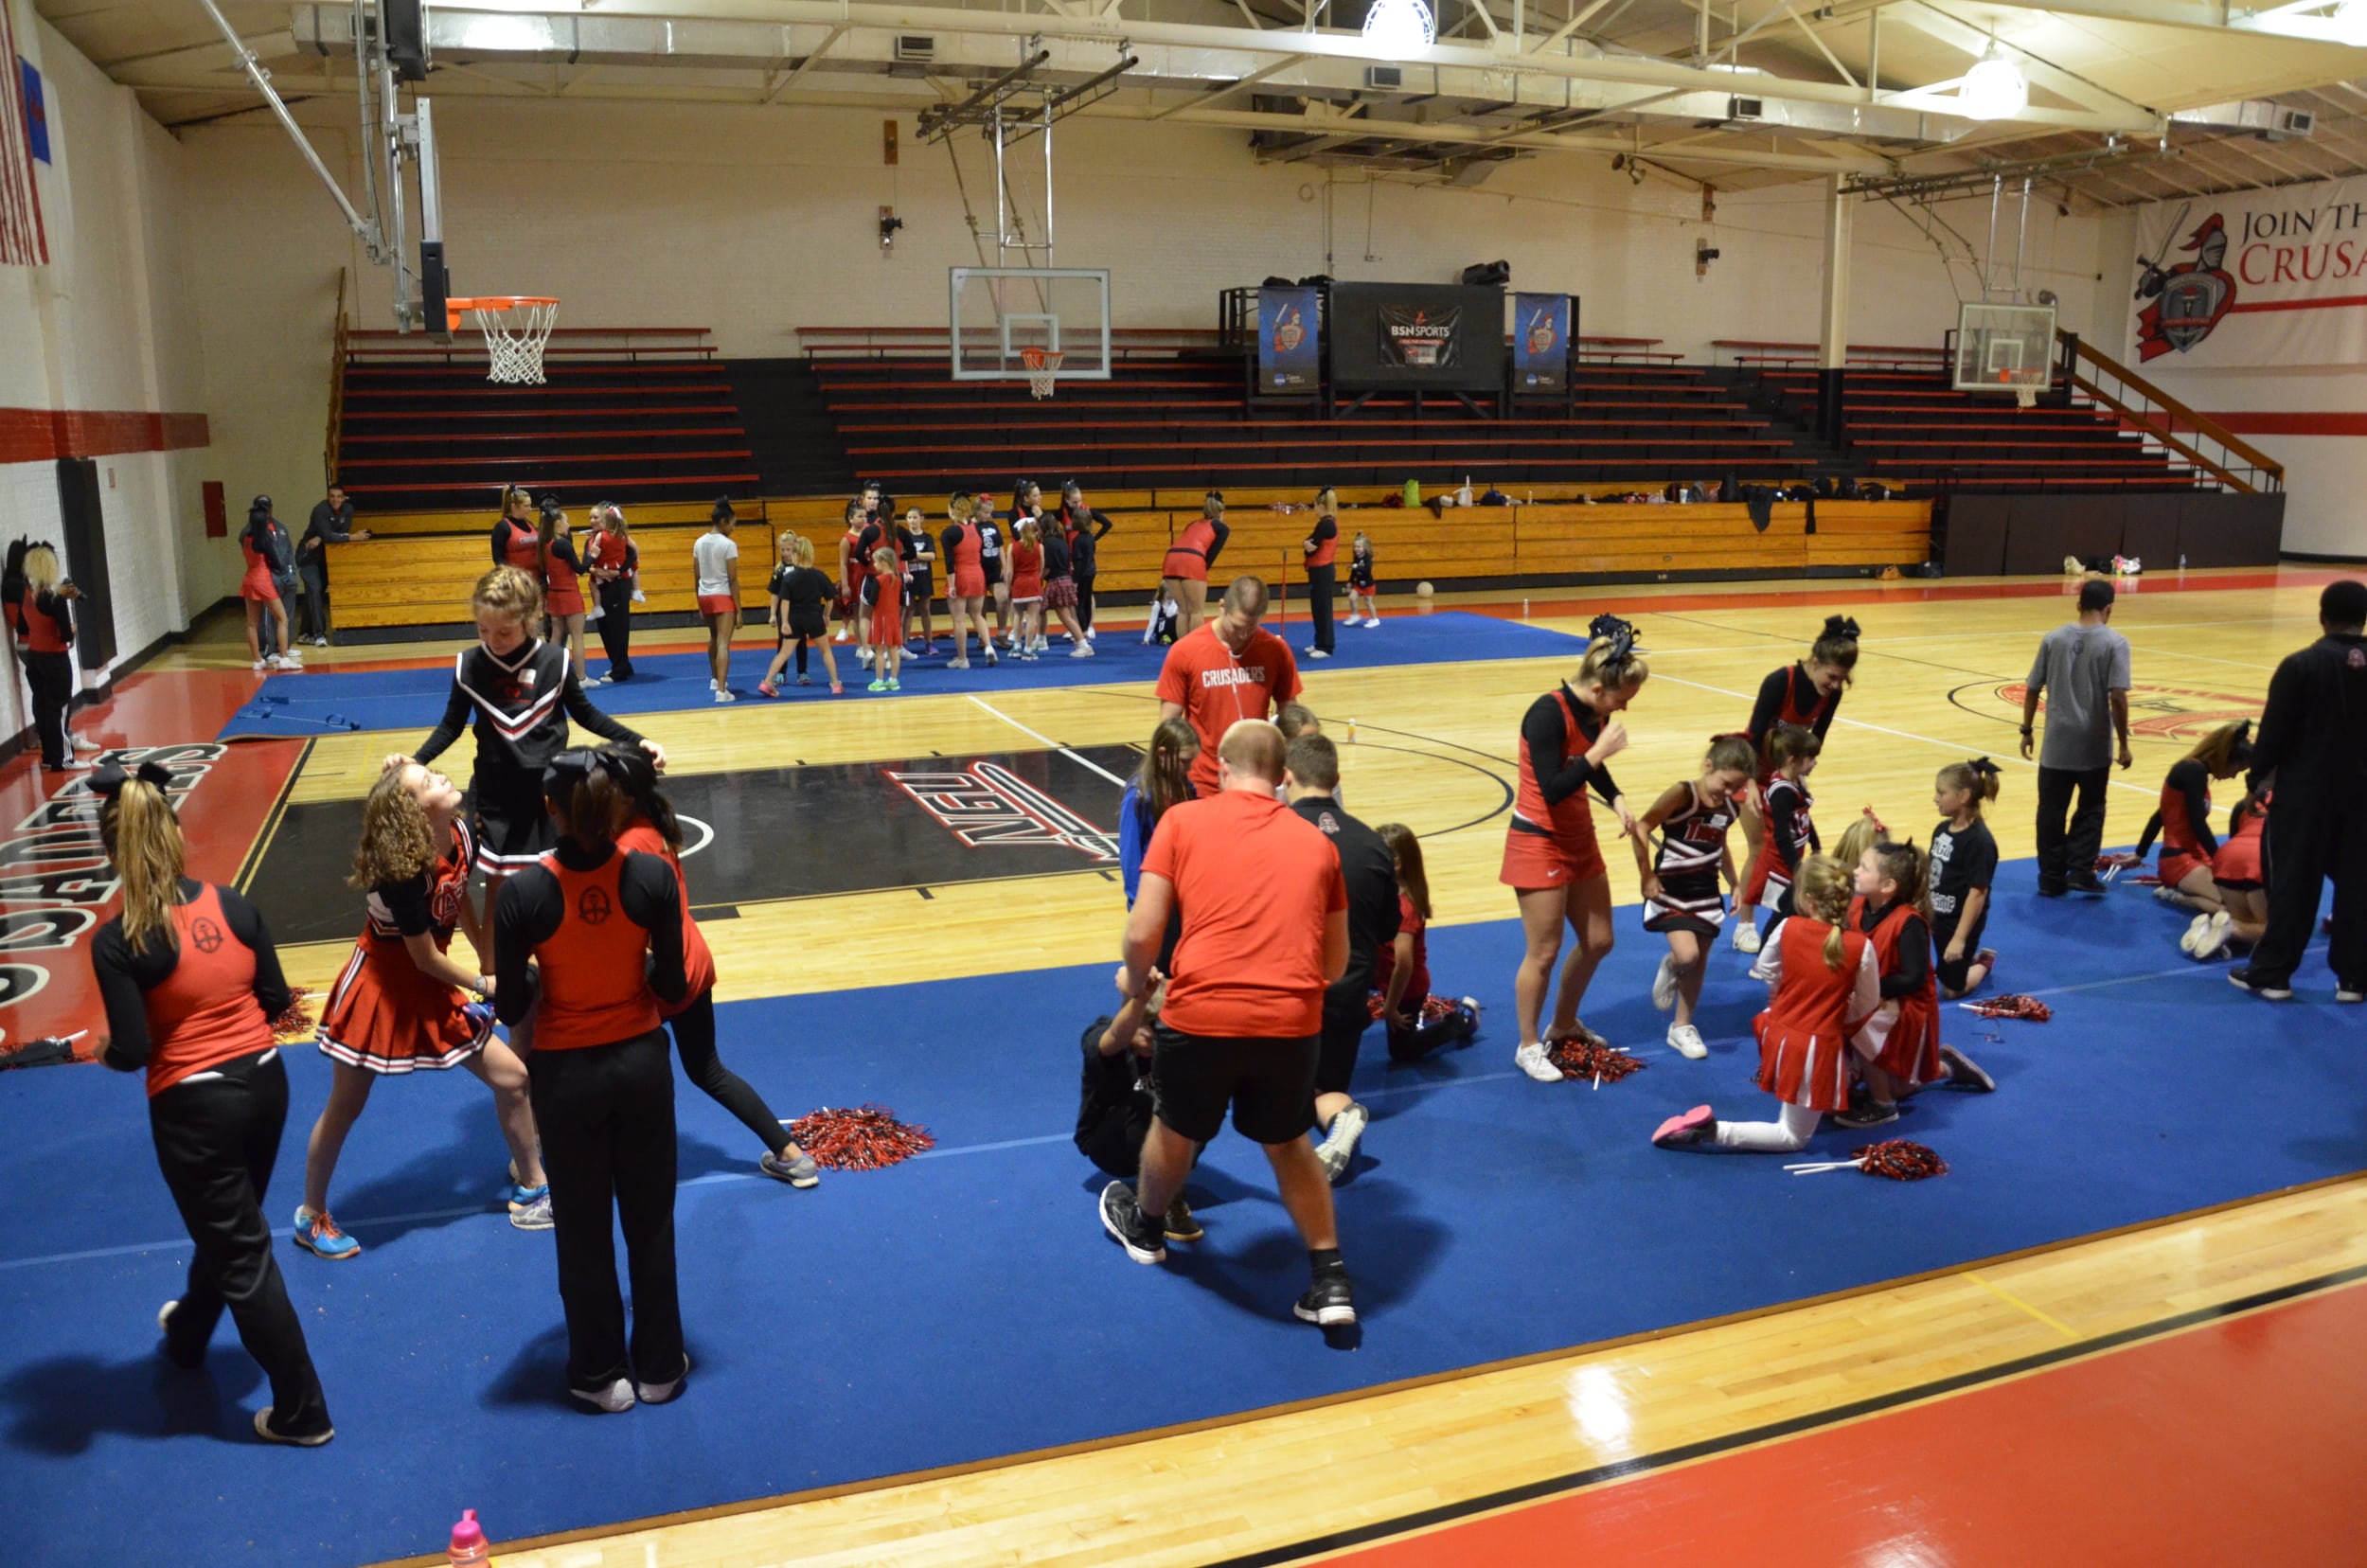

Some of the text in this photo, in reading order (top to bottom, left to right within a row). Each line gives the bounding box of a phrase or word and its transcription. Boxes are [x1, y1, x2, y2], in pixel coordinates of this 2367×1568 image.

[2241, 208, 2316, 247] JOIN
[1391, 325, 1450, 337] BSN SPORTS
[1201, 666, 1265, 688] CRUSADERS
